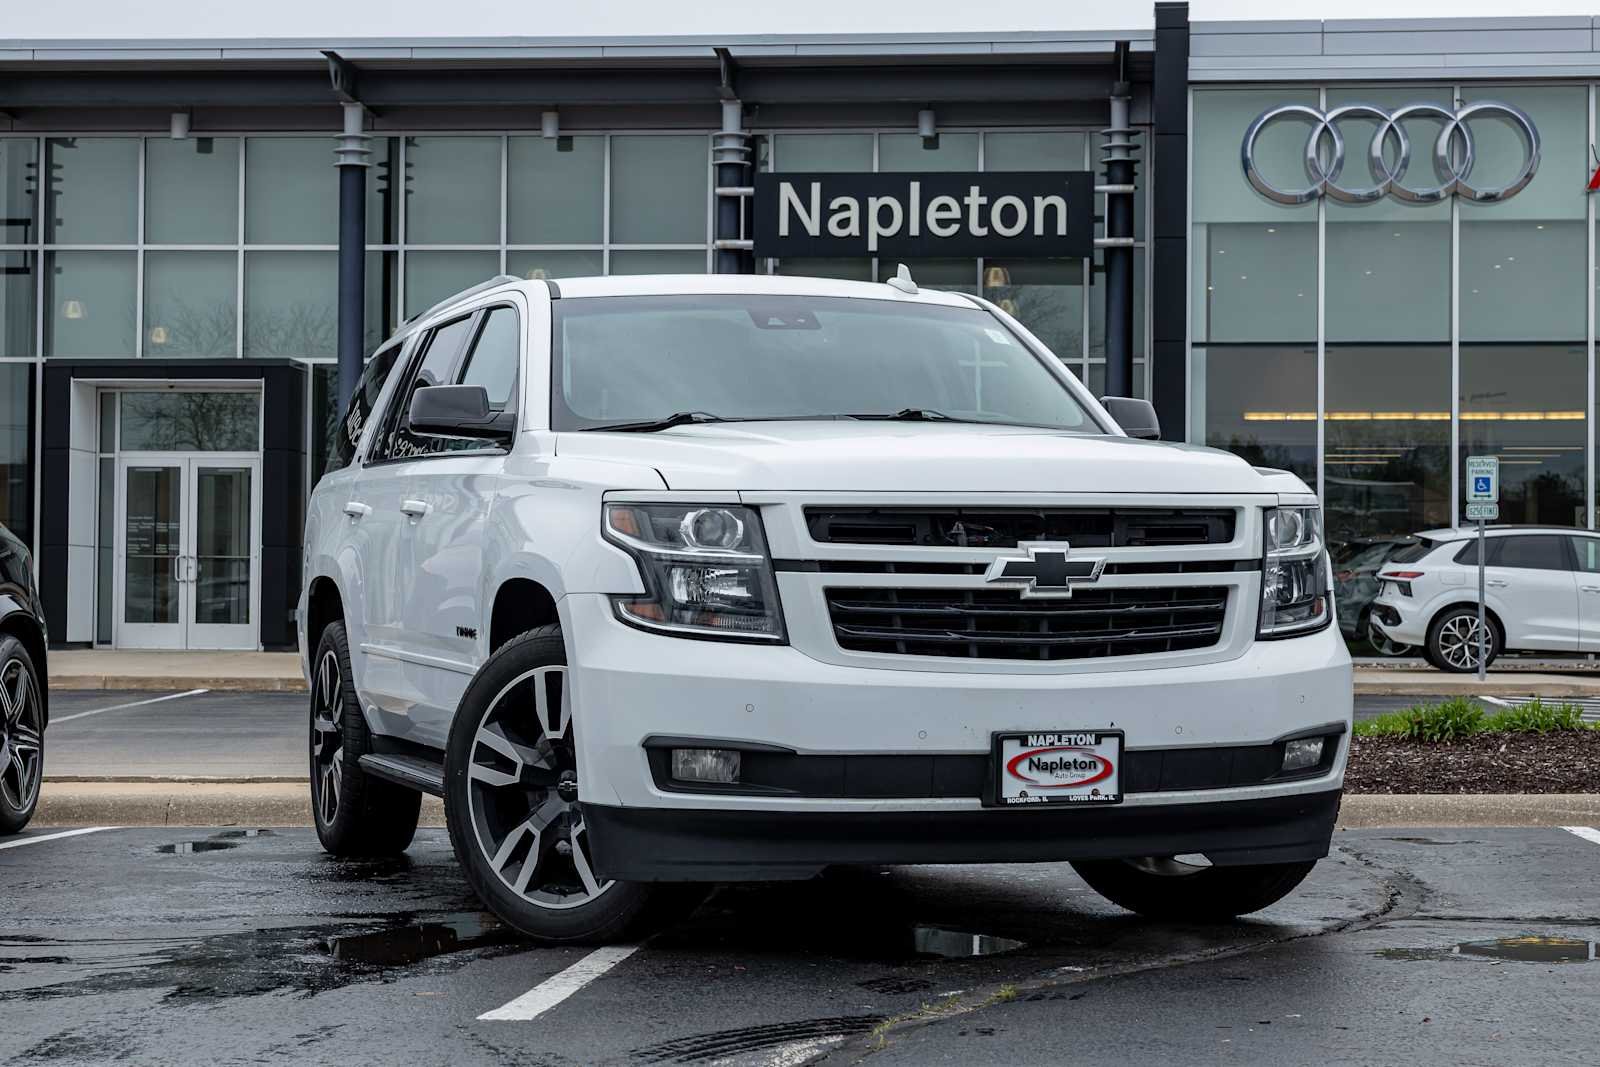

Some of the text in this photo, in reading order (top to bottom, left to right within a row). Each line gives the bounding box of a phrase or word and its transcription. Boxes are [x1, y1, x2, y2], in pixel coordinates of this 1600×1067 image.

[779, 181, 1068, 252] Napleton
[1028, 734, 1095, 746] NAPLETON
[1028, 757, 1097, 773] Napleton
[1070, 771, 1086, 779] Group
